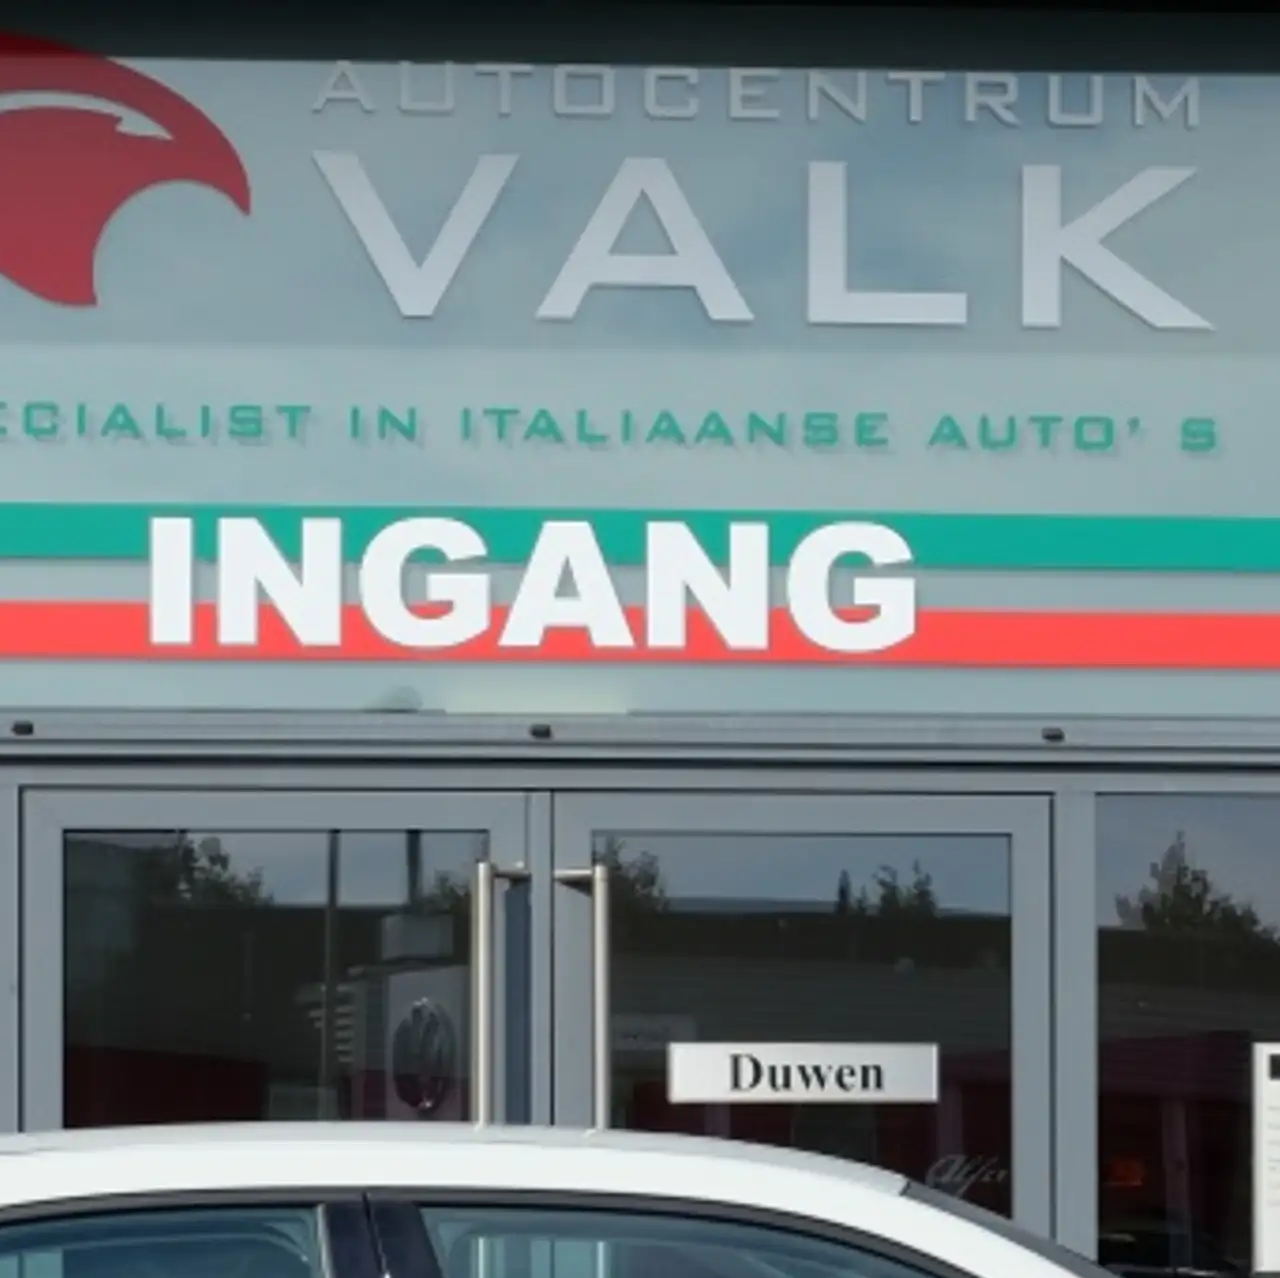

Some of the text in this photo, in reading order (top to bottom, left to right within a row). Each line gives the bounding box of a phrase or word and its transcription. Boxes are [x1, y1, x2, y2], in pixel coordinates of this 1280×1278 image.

[312, 60, 1200, 128] AUTOCENTRUM
[311, 150, 1216, 330] VALK
[349, 406, 417, 441] IN
[460, 407, 890, 447] ITALIAANSE
[149, 516, 917, 653] INGANG
[729, 1053, 885, 1092] Duwen
